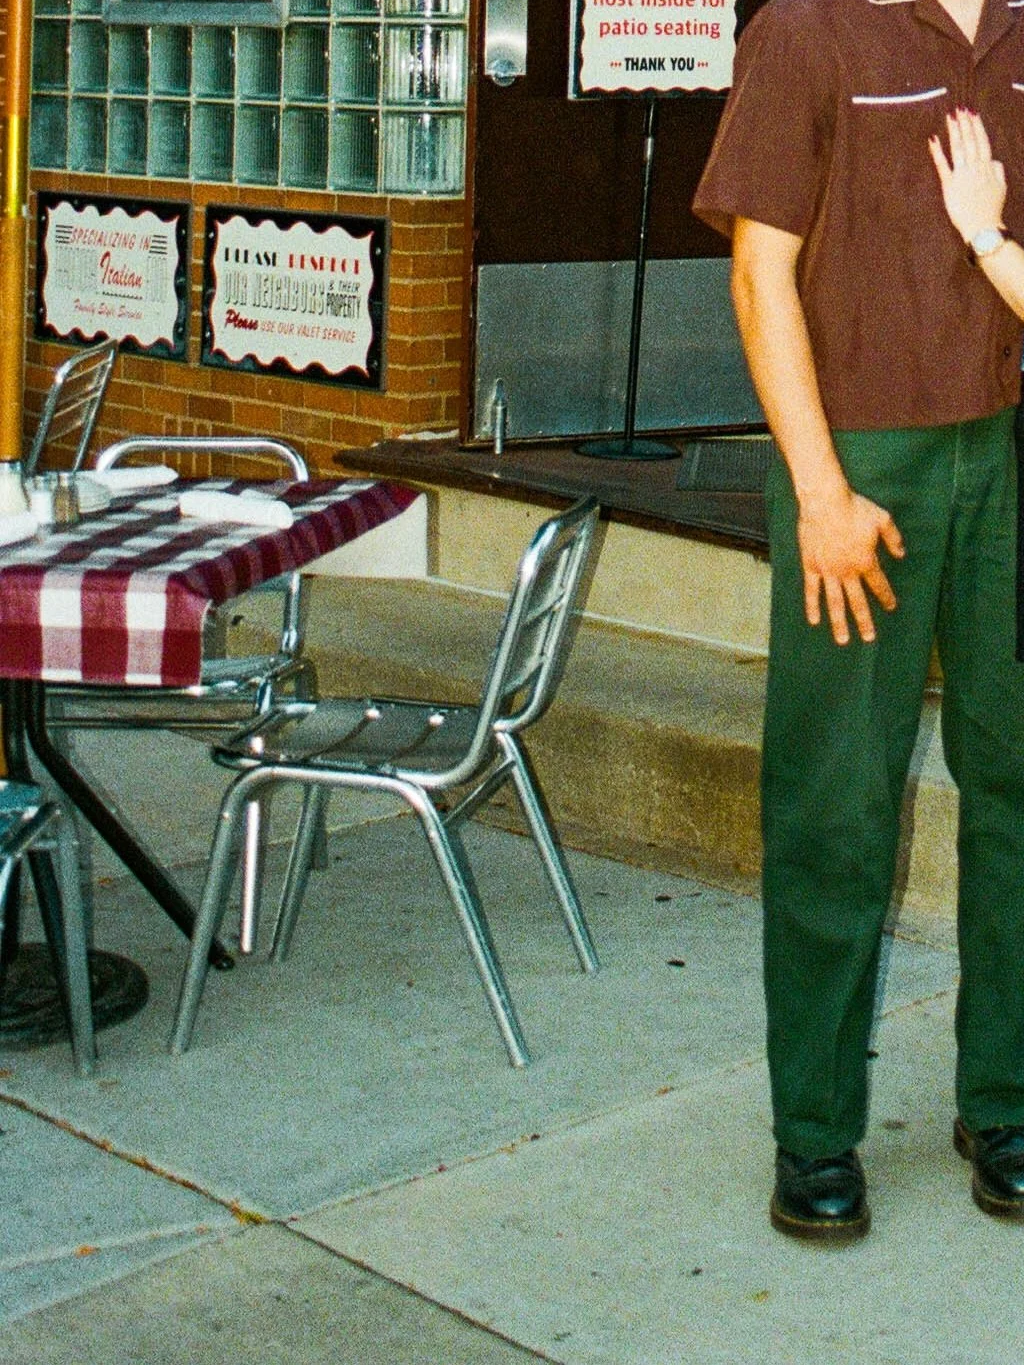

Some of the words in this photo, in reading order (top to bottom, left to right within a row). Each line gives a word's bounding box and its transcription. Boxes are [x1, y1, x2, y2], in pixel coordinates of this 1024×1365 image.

[599, 18, 648, 38] patio
[654, 19, 721, 39] seating
[624, 57, 666, 72] THANK
[671, 57, 695, 71] YOU
[70, 226, 137, 251] SPECIALIZING
[99, 250, 143, 288] Italian
[322, 327, 357, 344] SERVICE
